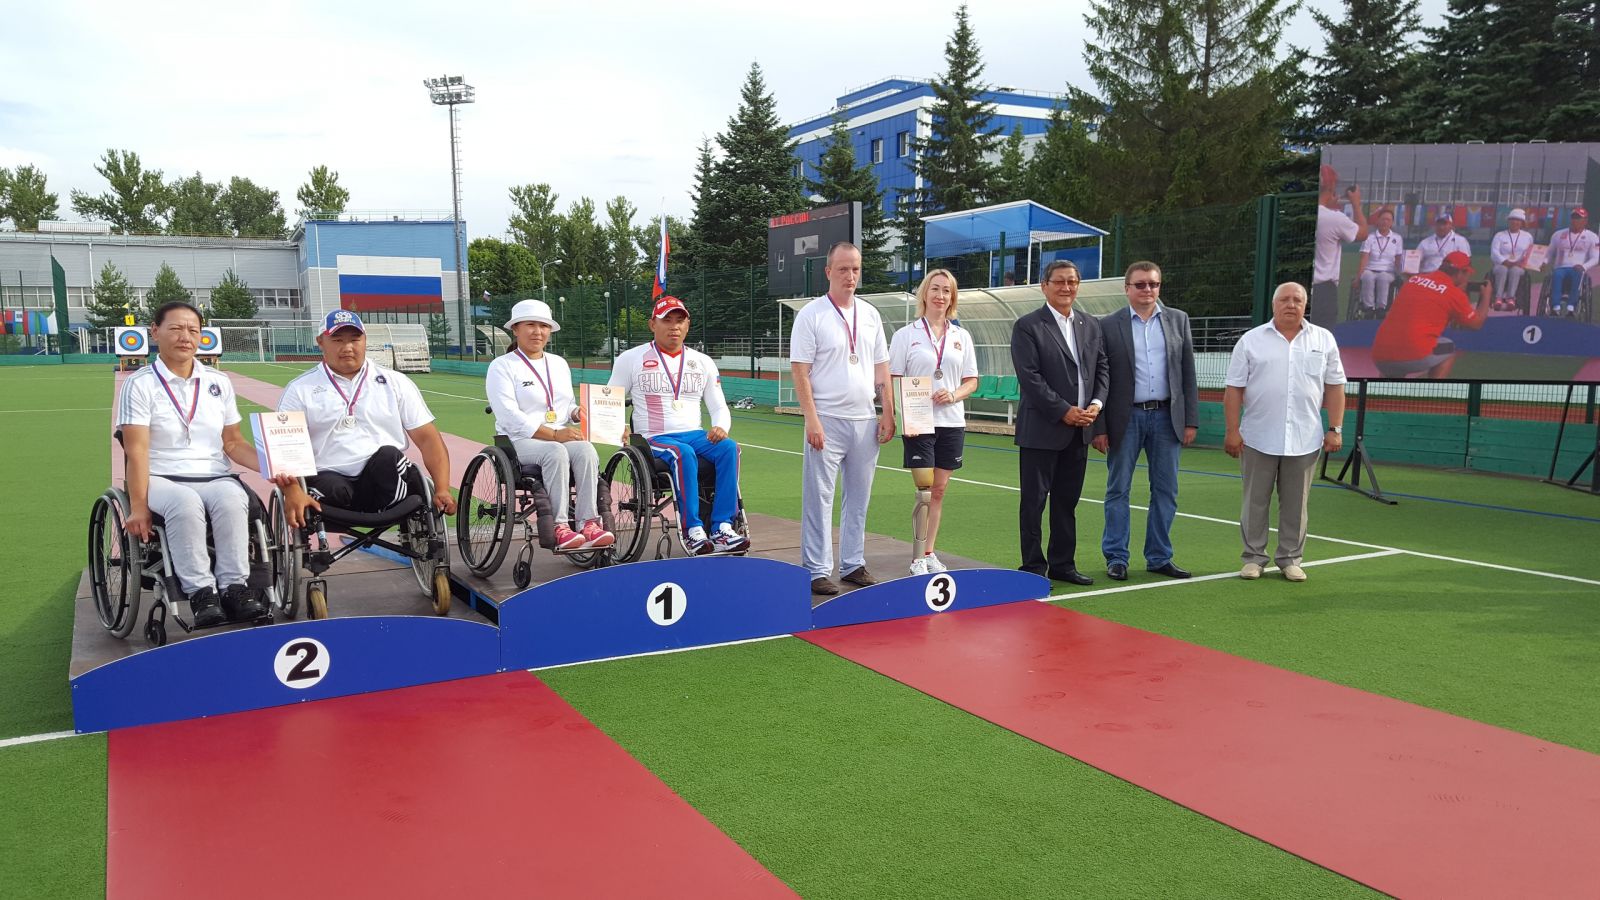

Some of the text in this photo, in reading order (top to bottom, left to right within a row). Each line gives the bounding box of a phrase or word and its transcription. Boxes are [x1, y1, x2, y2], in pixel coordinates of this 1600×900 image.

[1408, 275, 1447, 293] СУДЬЯ
[1526, 327, 1536, 342] 1
[270, 427, 305, 436] ДИПЛОМ
[655, 587, 673, 620] 1
[931, 577, 951, 607] 3
[285, 641, 321, 682] 2
